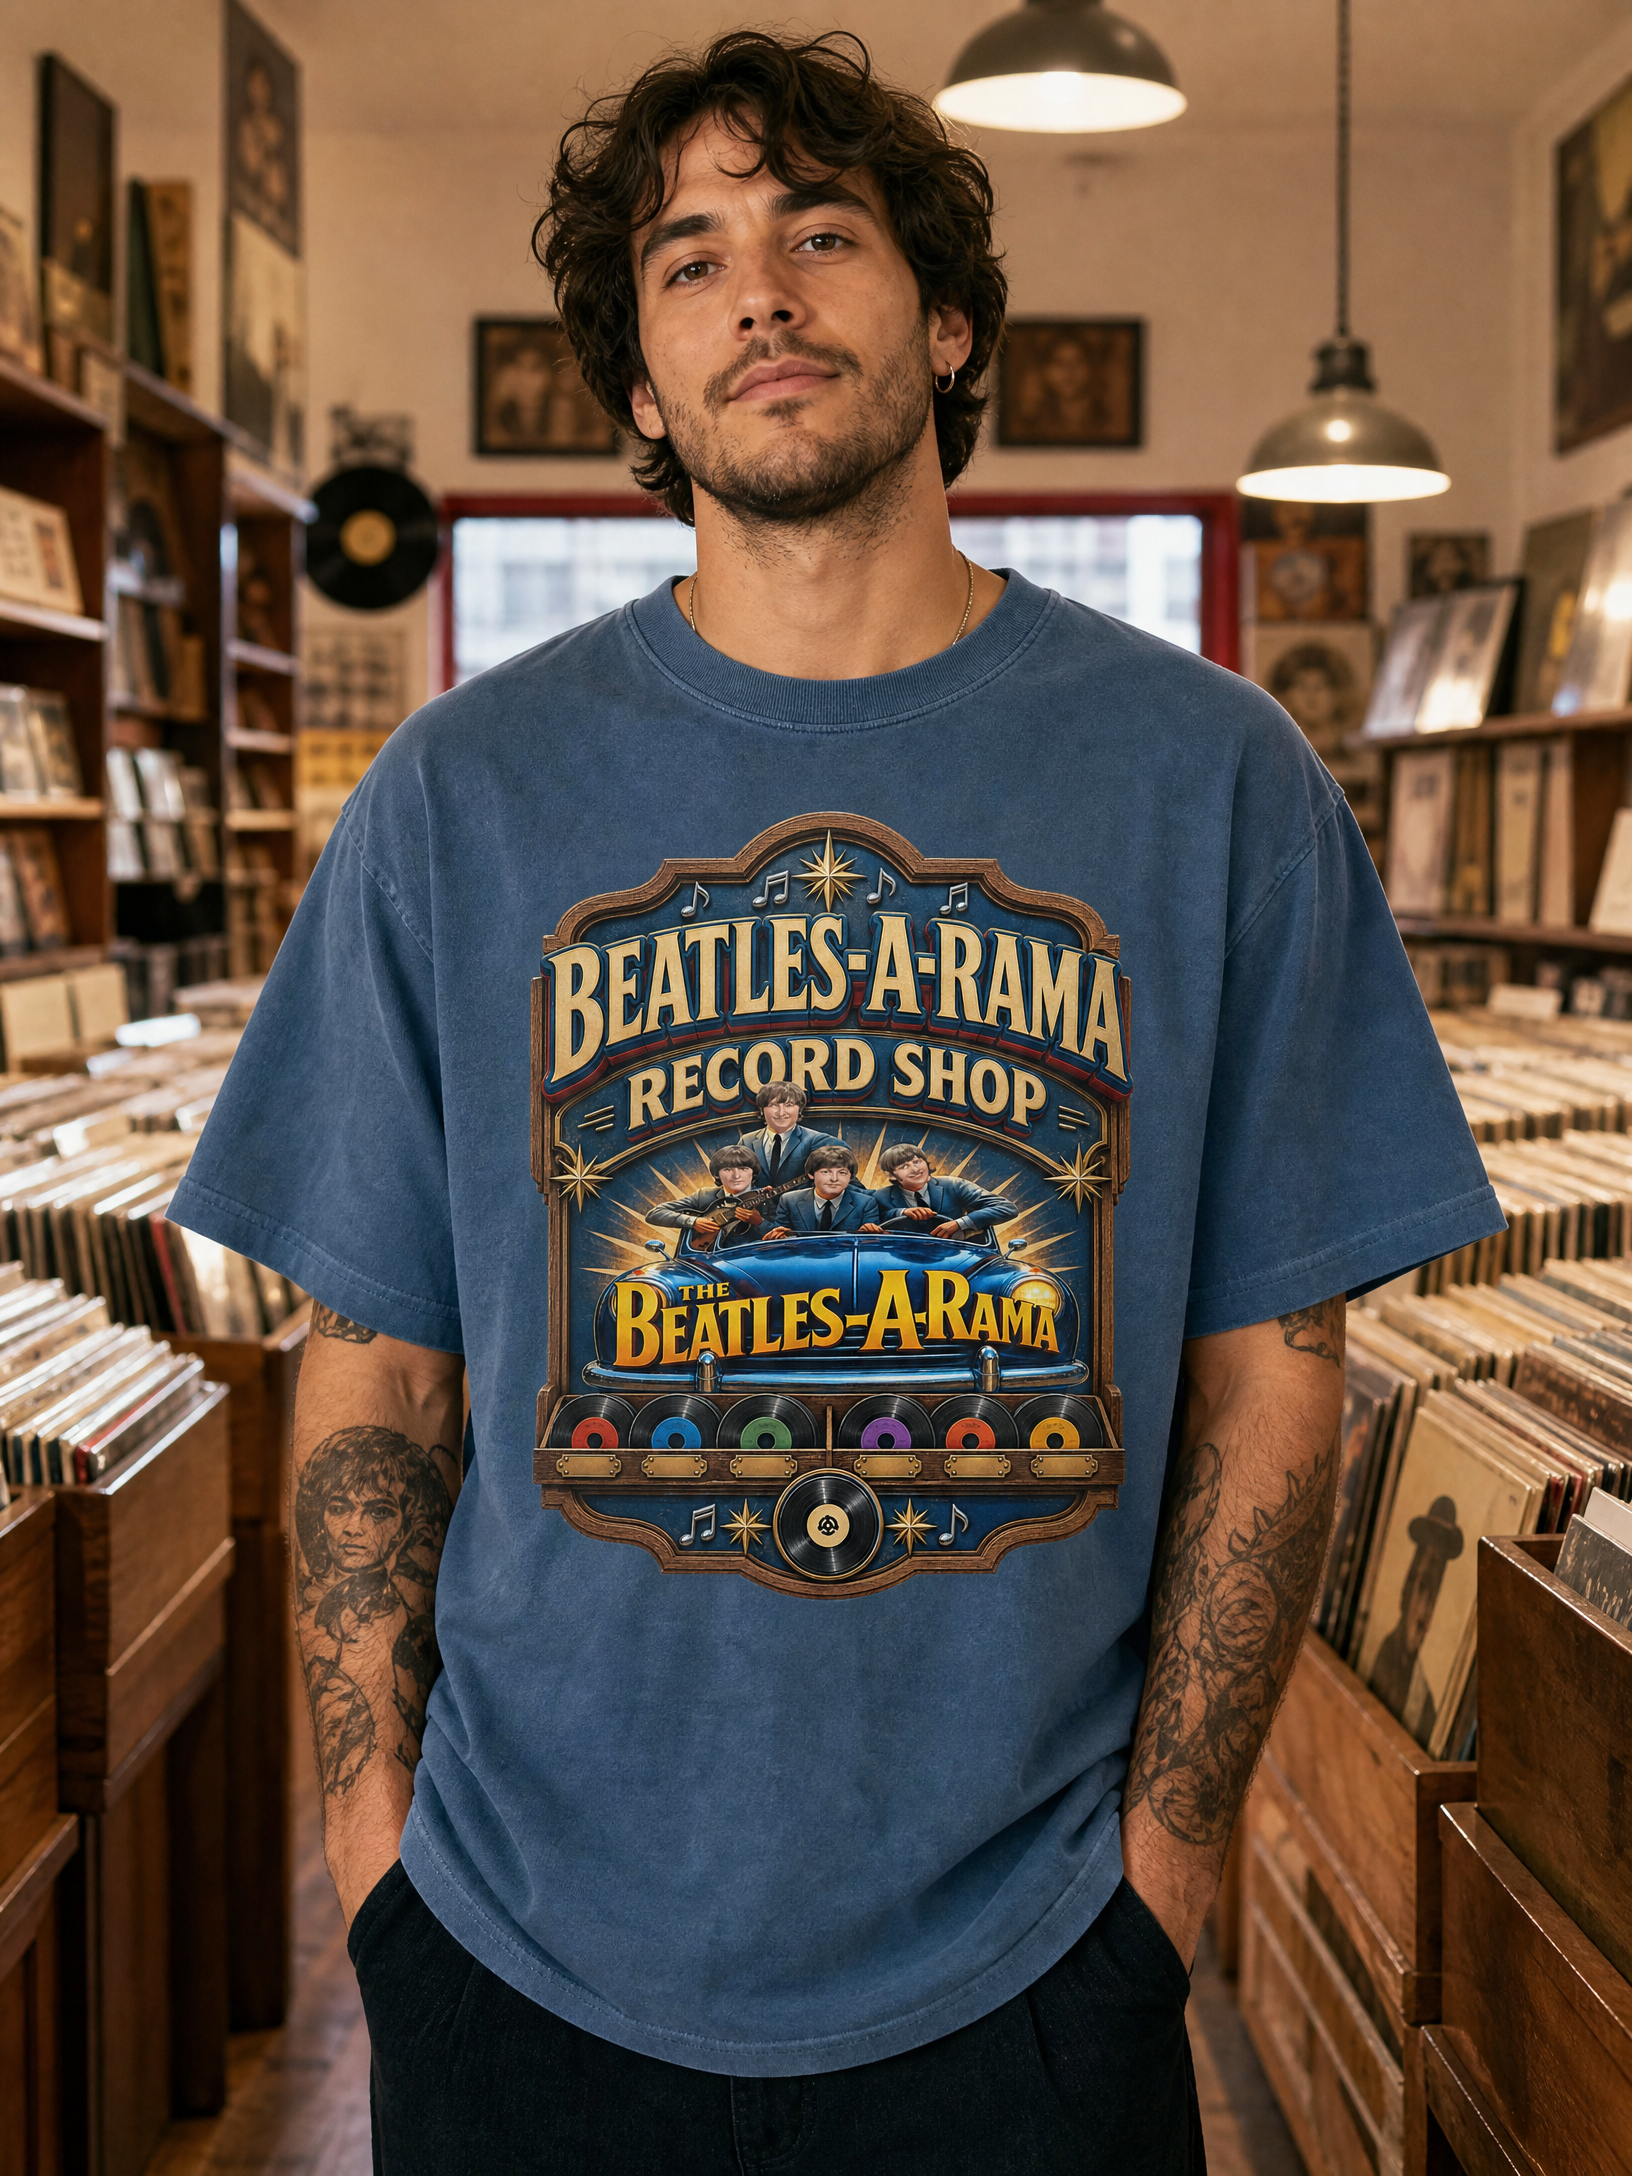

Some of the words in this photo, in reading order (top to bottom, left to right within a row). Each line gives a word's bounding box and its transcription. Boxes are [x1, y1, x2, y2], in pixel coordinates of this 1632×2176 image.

[544, 911, 1130, 1086] BEATLES-A-RAMA
[627, 1037, 876, 1131] RECORD
[893, 1043, 1047, 1126] SHOP
[613, 1269, 1060, 1368] BEATLES-A-RAMA
[678, 1281, 730, 1302] THE
